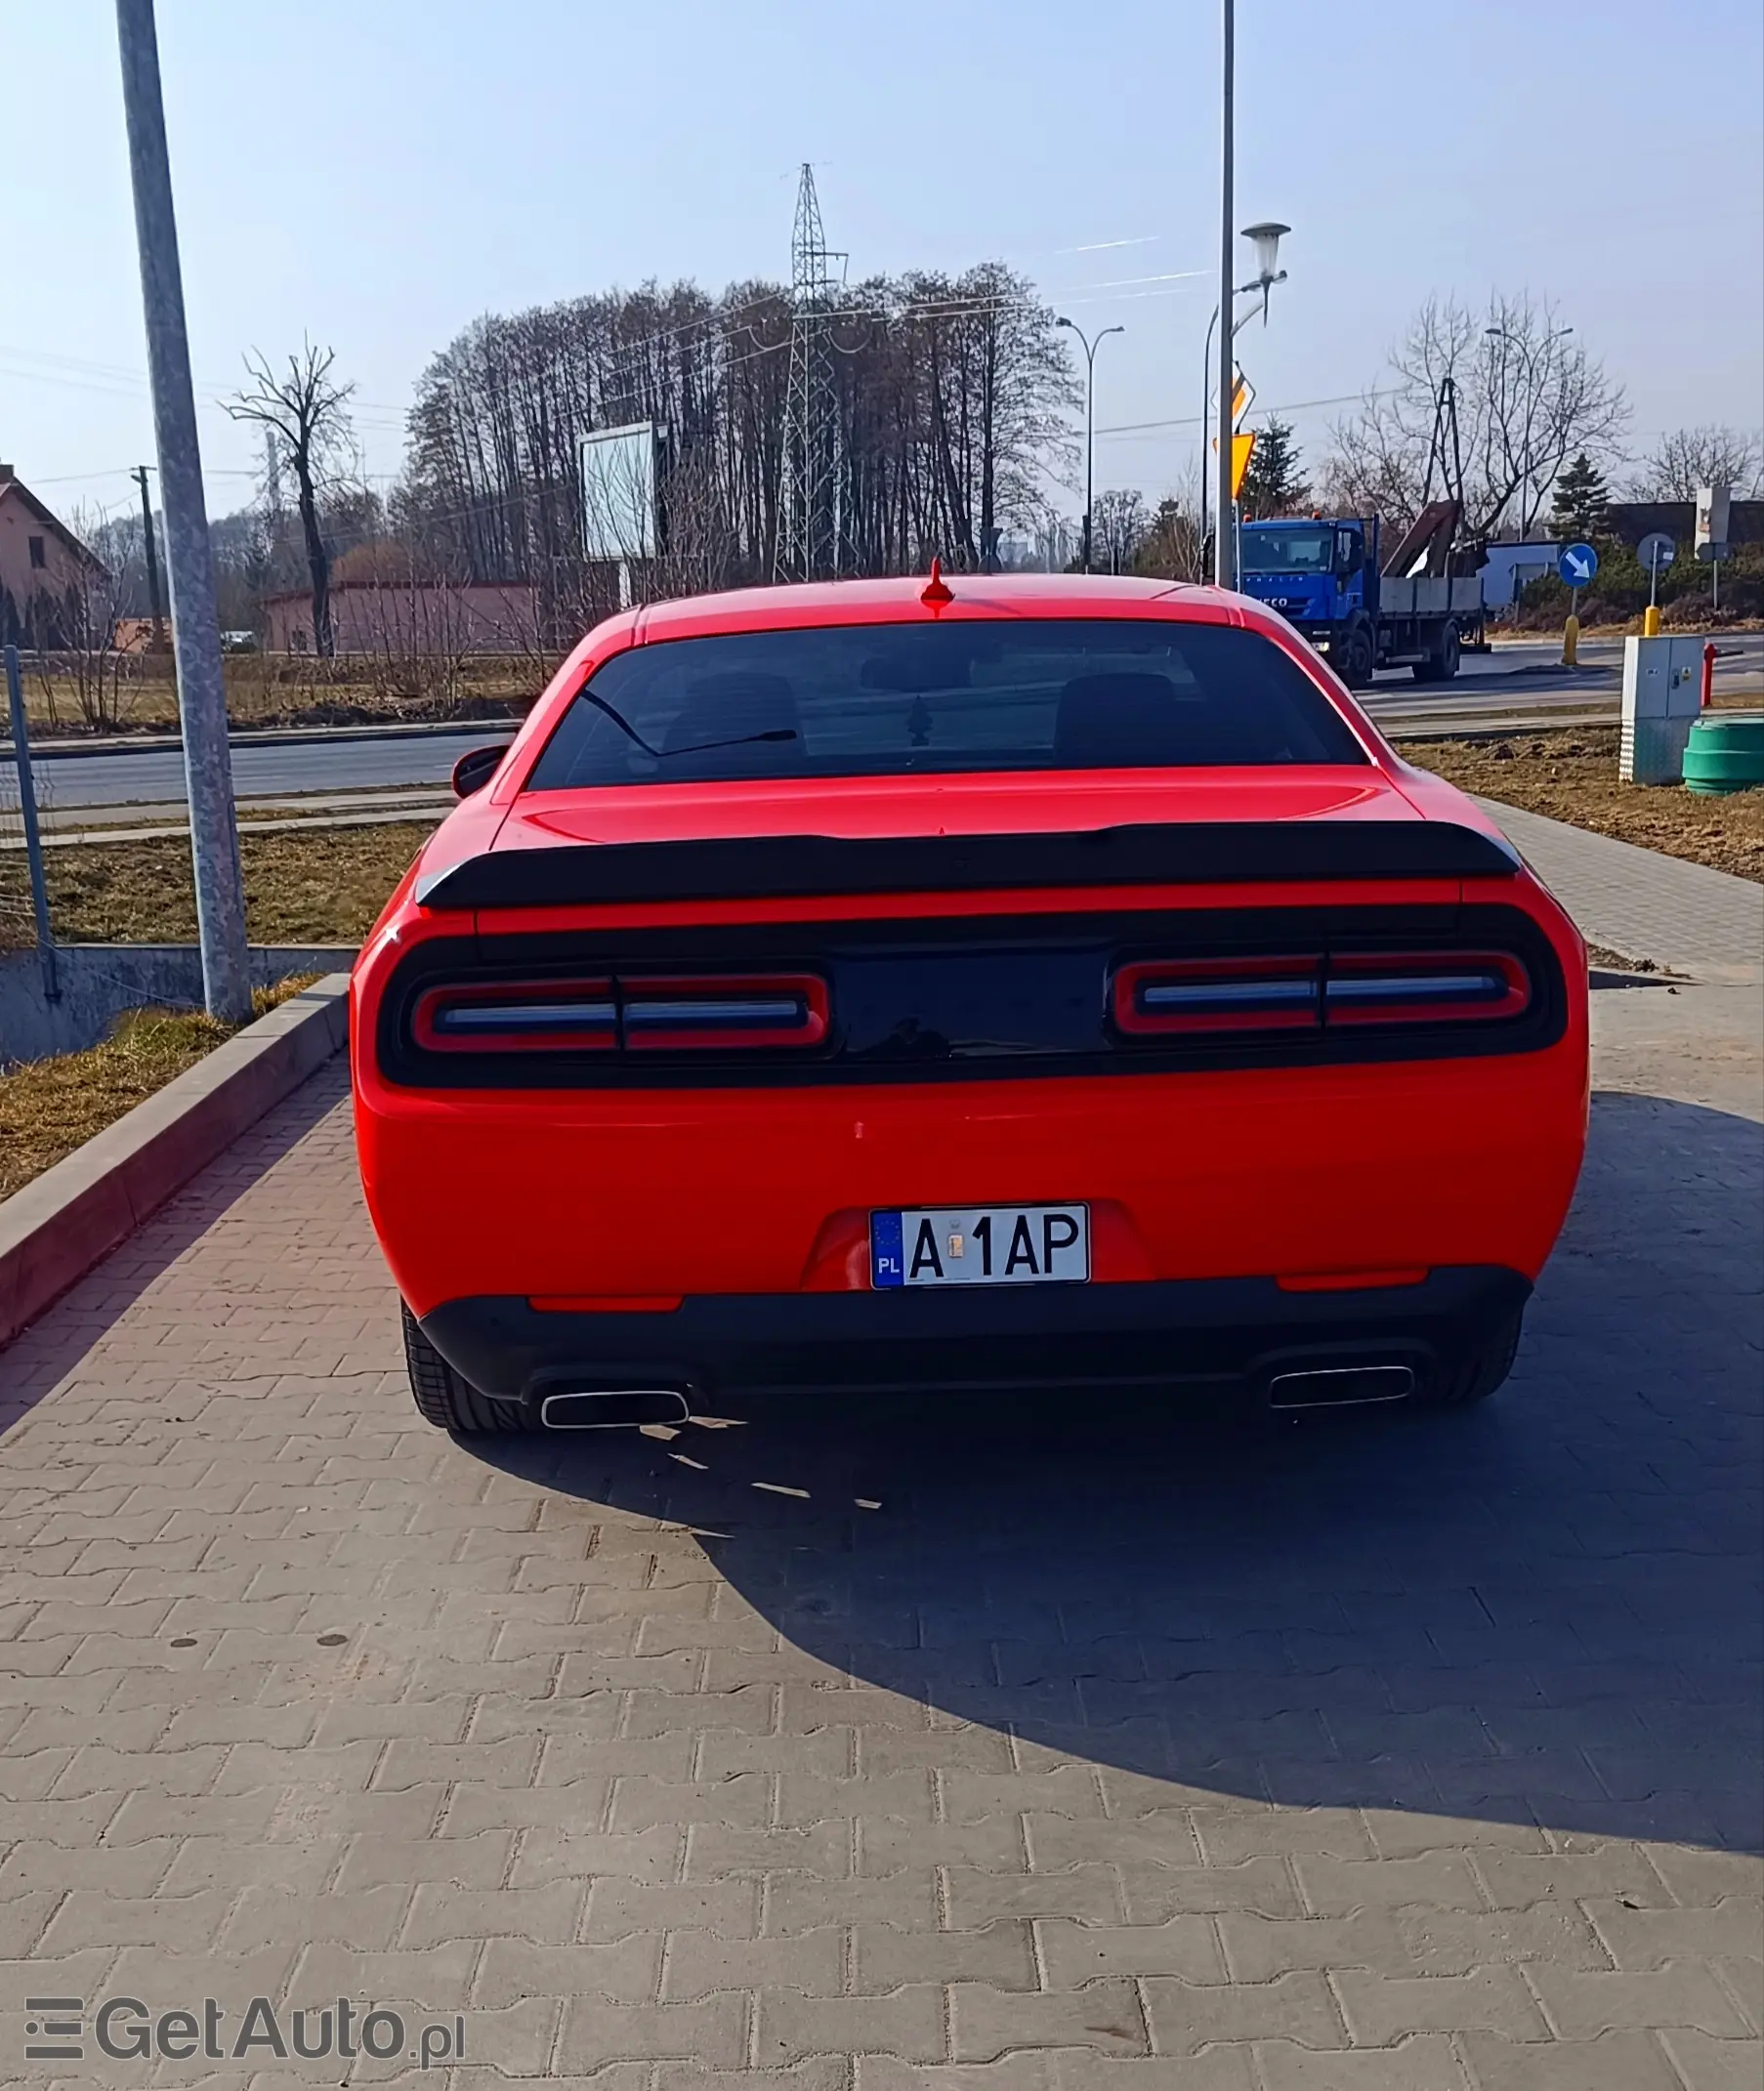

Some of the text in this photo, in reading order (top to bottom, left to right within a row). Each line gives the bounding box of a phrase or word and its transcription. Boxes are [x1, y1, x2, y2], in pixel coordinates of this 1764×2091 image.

[1257, 597, 1288, 607] ECO
[908, 1213, 1079, 1278] A 1AP
[878, 1257, 901, 1274] PL
